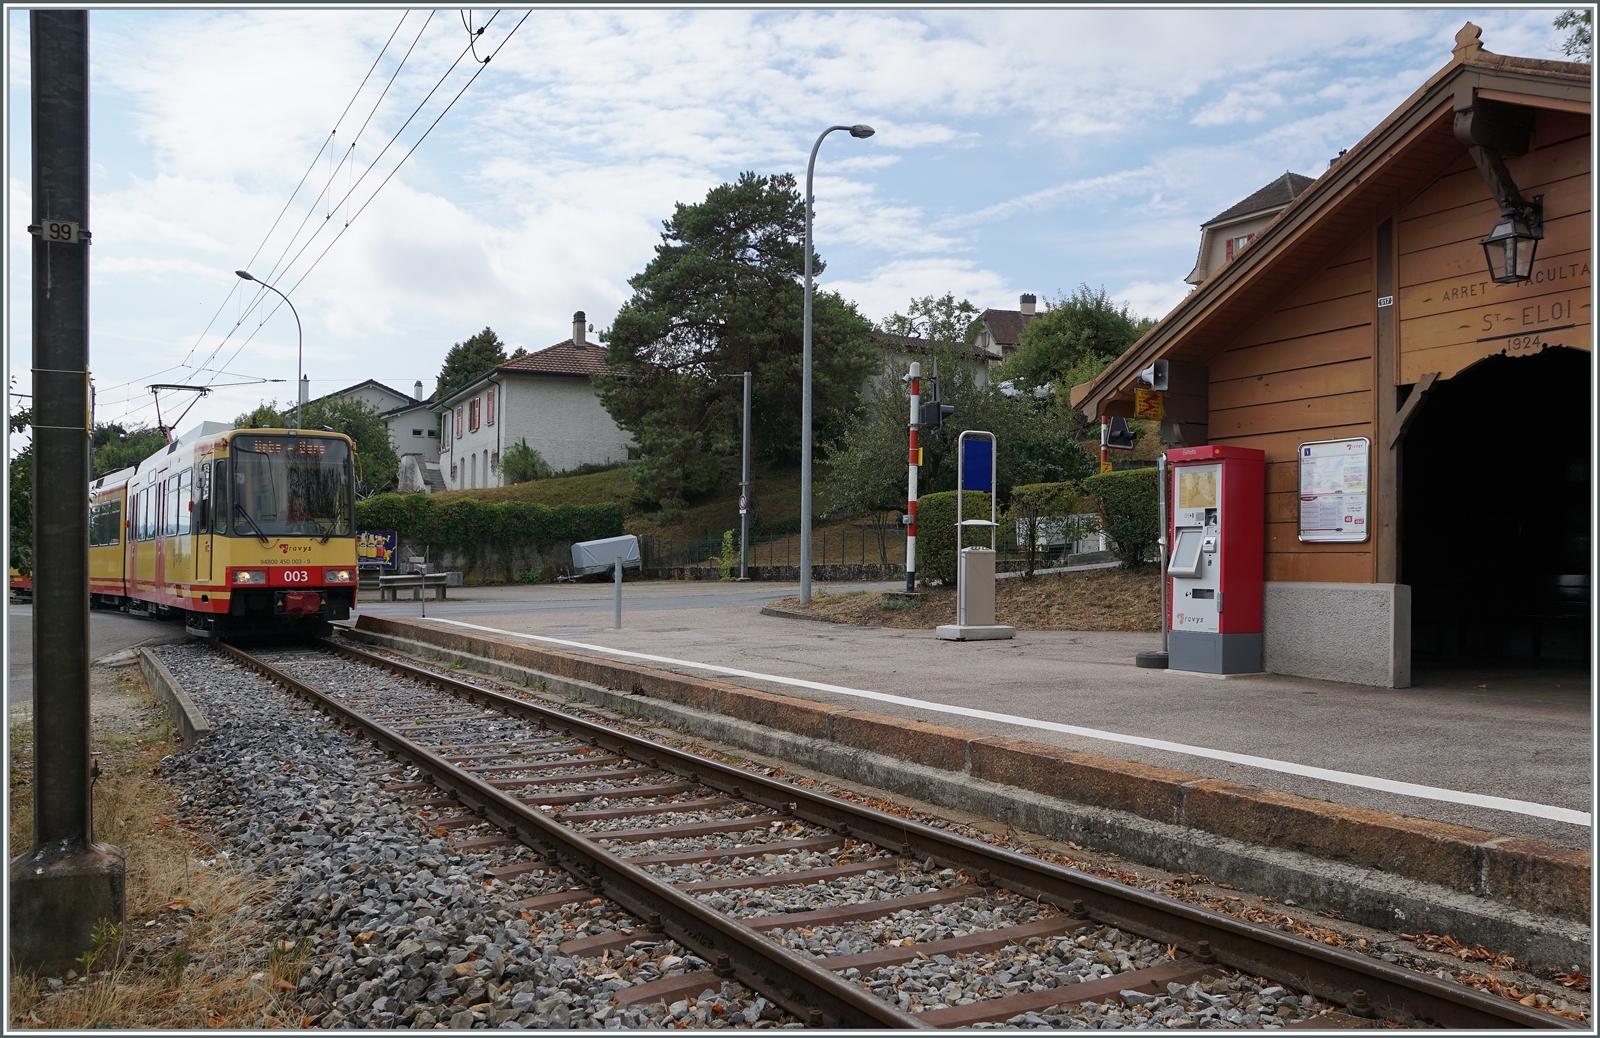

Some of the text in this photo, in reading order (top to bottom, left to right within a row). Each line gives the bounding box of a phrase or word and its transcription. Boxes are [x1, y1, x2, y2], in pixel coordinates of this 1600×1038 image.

[50, 223, 71, 240] 99
[1442, 281, 1489, 302] ARRET
[1522, 299, 1572, 326] ELOI
[1506, 335, 1542, 351] 1924
[283, 570, 309, 582] 003
